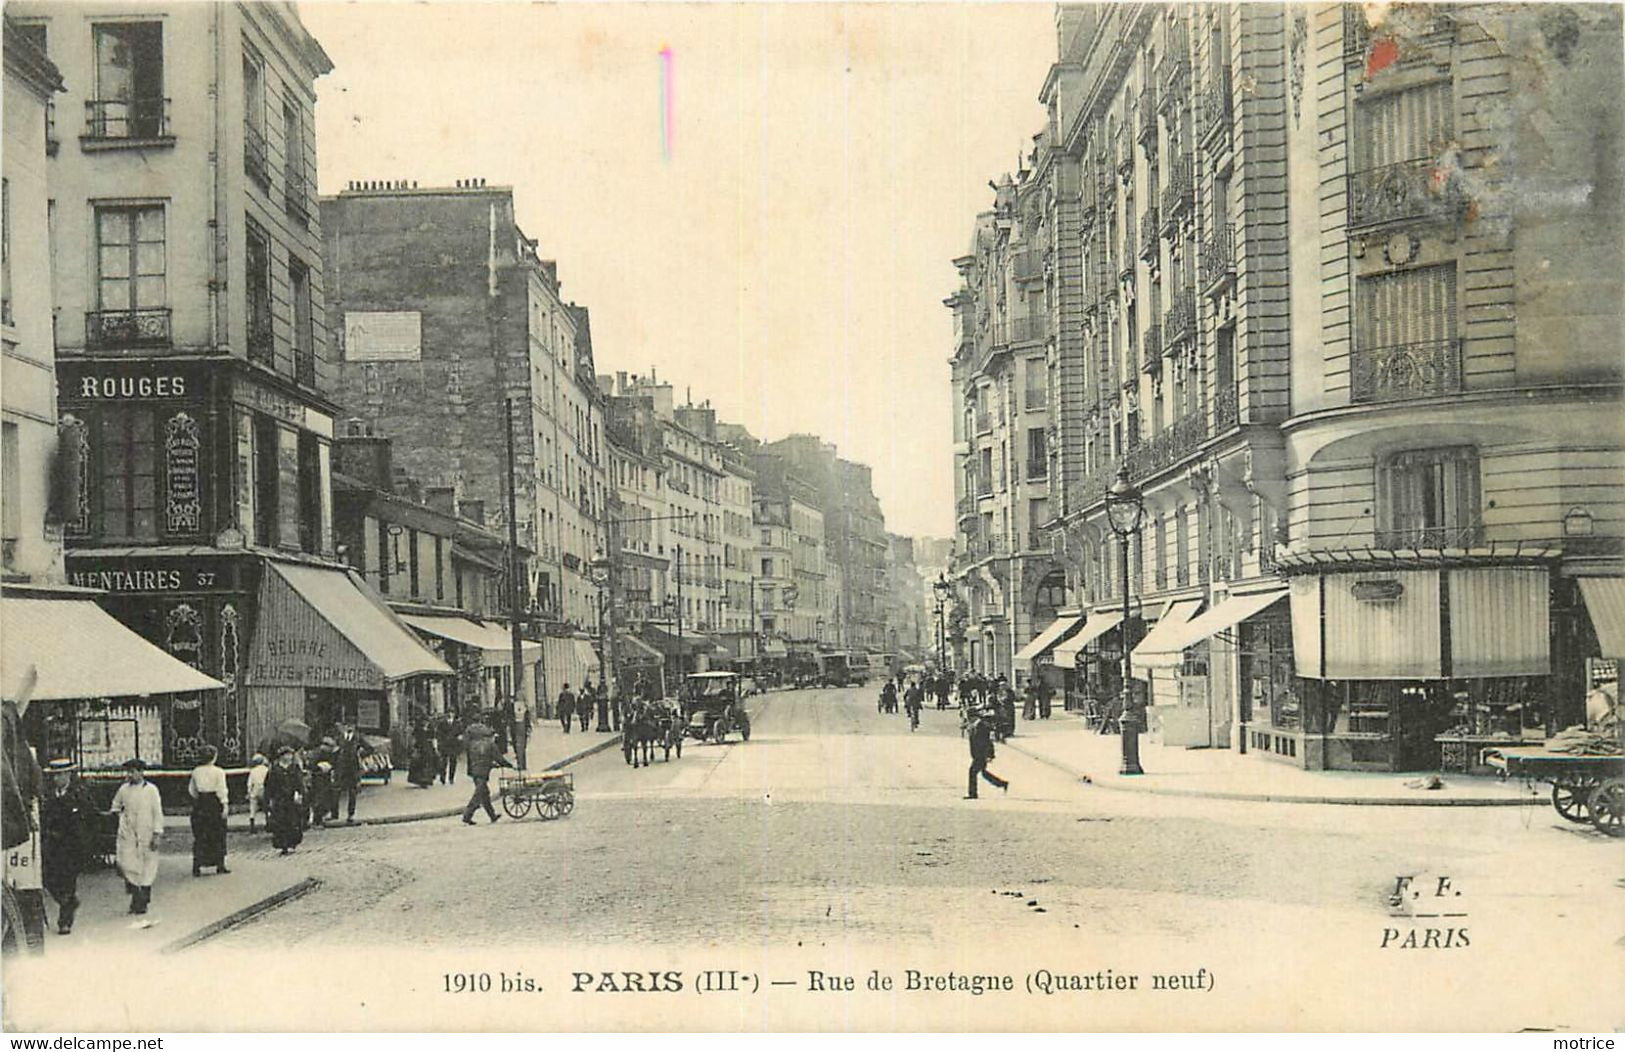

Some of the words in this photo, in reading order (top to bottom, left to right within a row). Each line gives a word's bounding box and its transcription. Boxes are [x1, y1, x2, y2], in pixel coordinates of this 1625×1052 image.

[81, 376, 185, 397] ROUGES
[197, 572, 216, 586] 37
[10, 851, 29, 867] de
